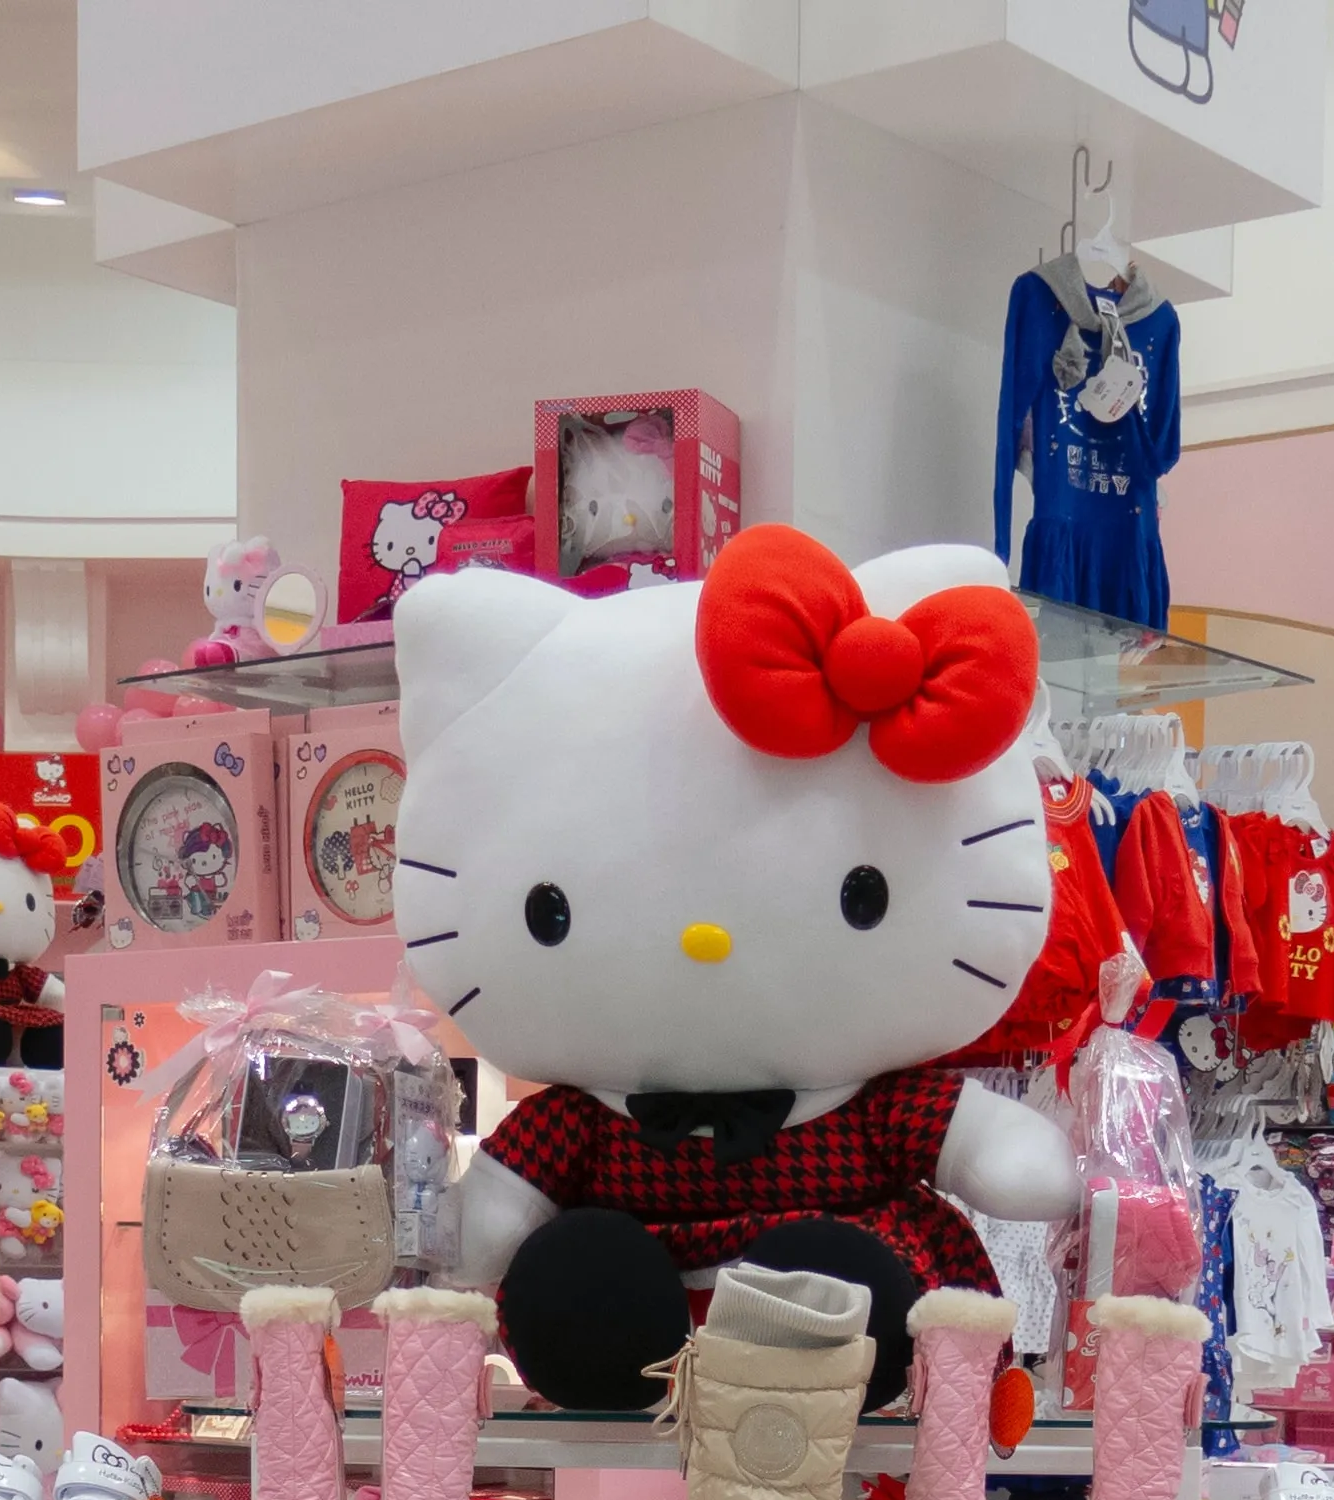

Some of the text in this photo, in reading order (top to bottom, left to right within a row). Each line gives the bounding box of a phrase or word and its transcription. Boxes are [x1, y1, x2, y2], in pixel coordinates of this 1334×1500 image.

[700, 441, 723, 468] HELLO
[700, 461, 723, 487] KITTY
[344, 783, 375, 798] HELLO
[346, 795, 375, 810] KITTY
[99, 1469, 123, 1482] Hello
